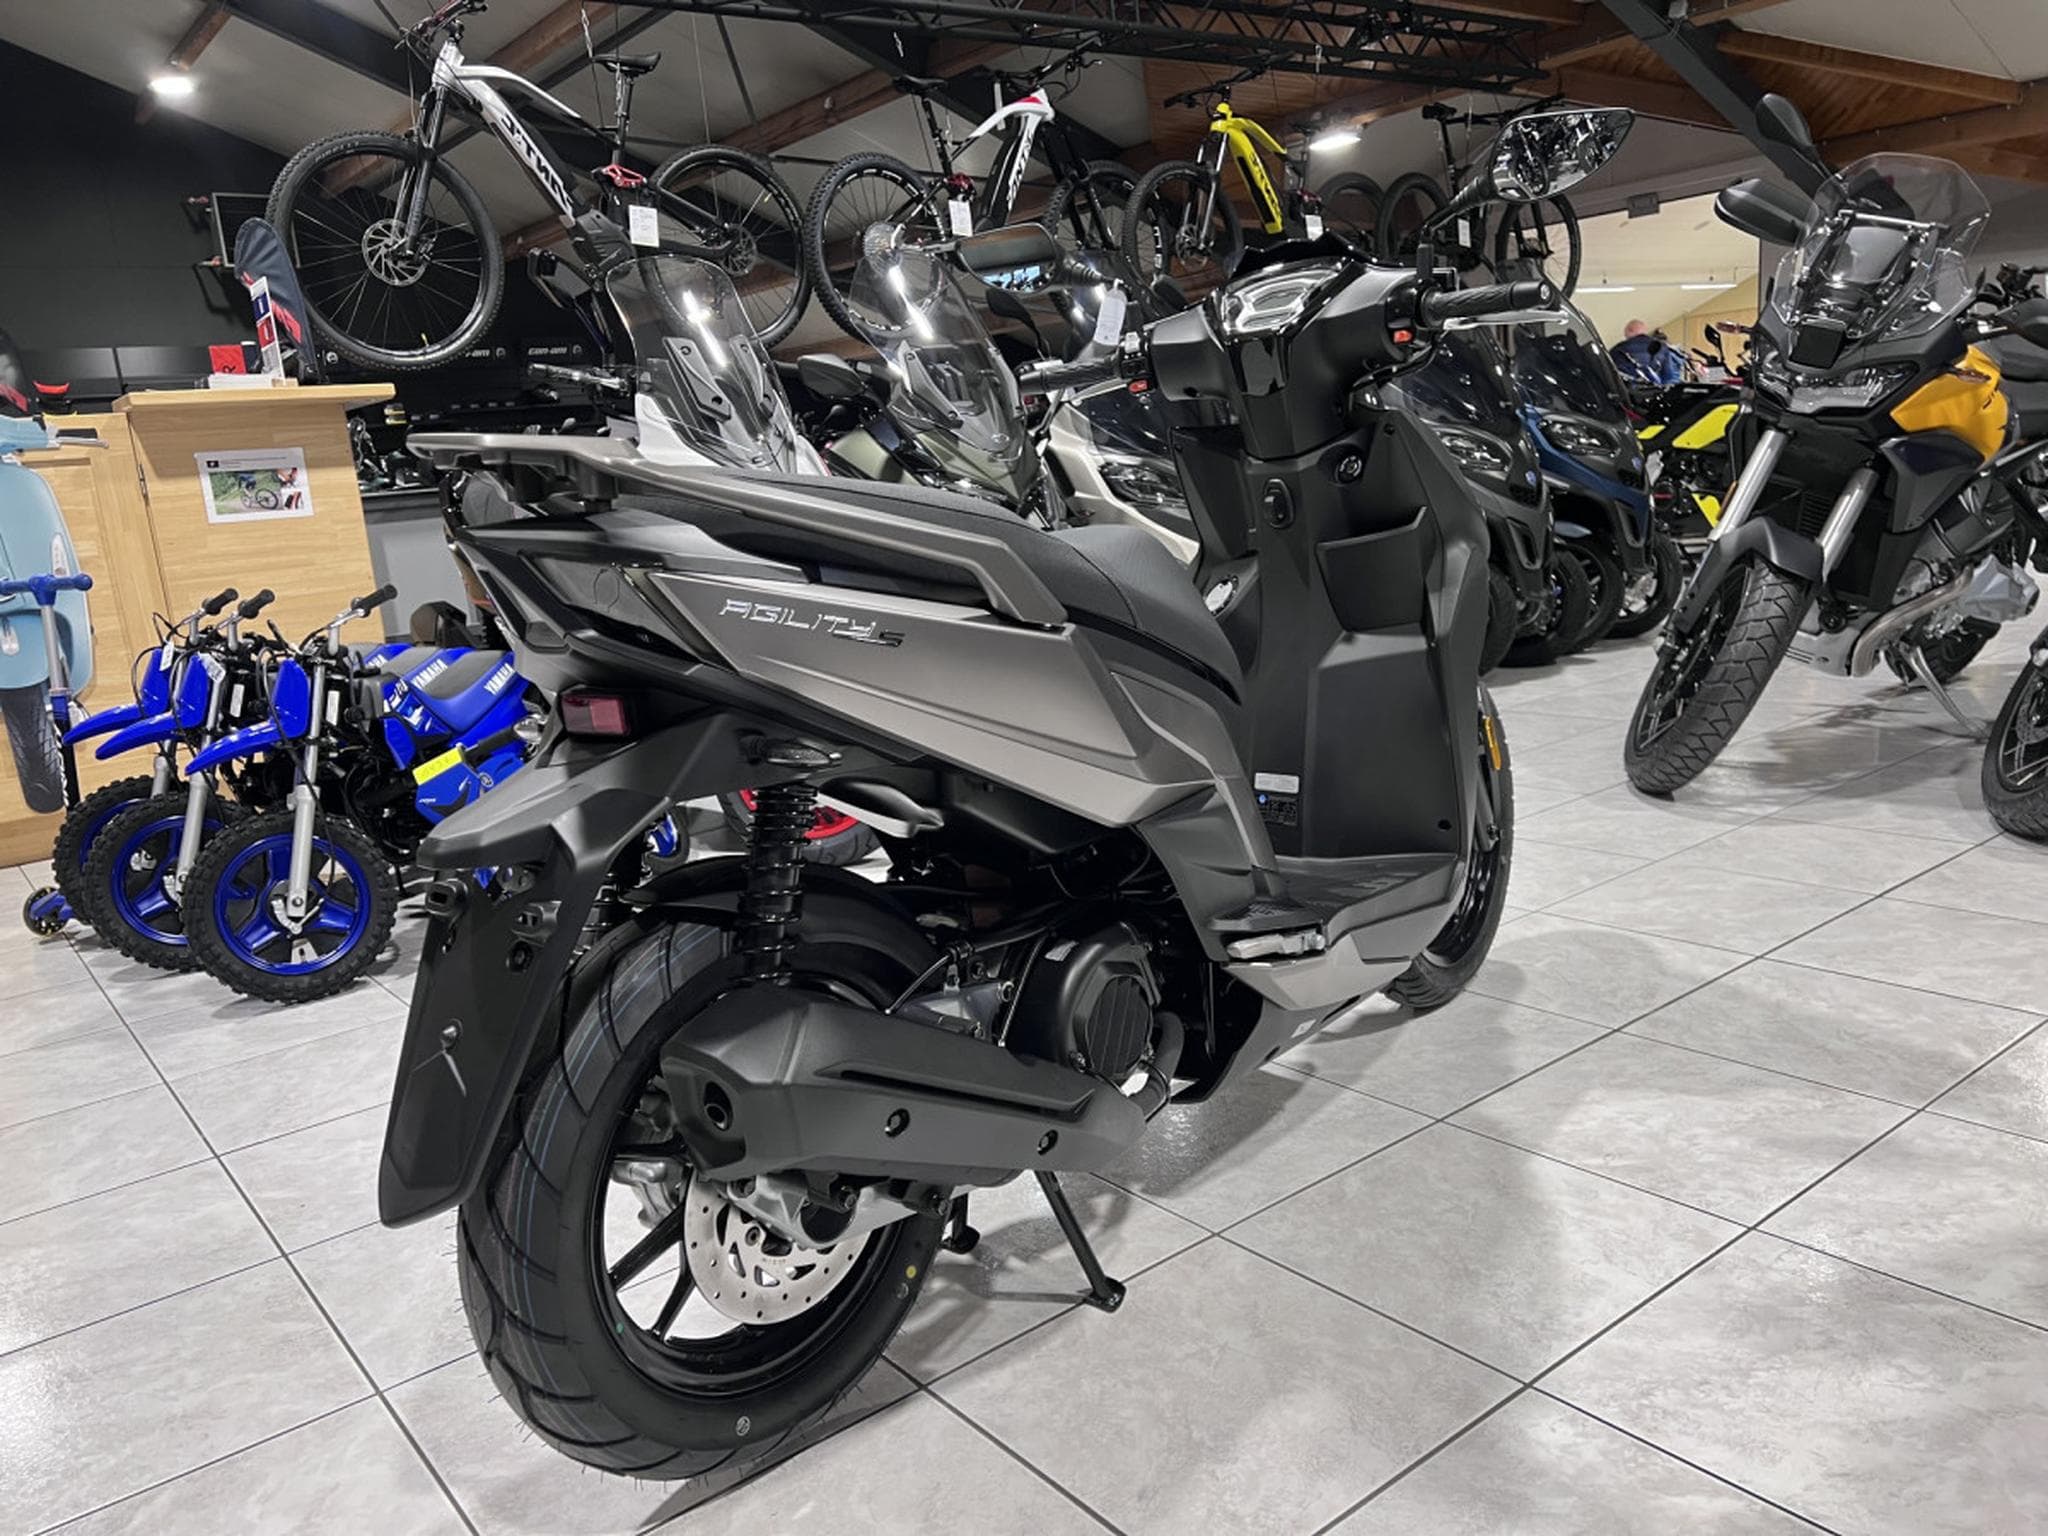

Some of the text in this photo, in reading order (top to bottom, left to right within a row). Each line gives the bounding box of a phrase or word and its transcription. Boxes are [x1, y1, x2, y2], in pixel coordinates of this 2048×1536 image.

[719, 599, 876, 637] AGILITY
[410, 658, 449, 689] YAMAHA
[484, 662, 517, 696] YAMAHA
